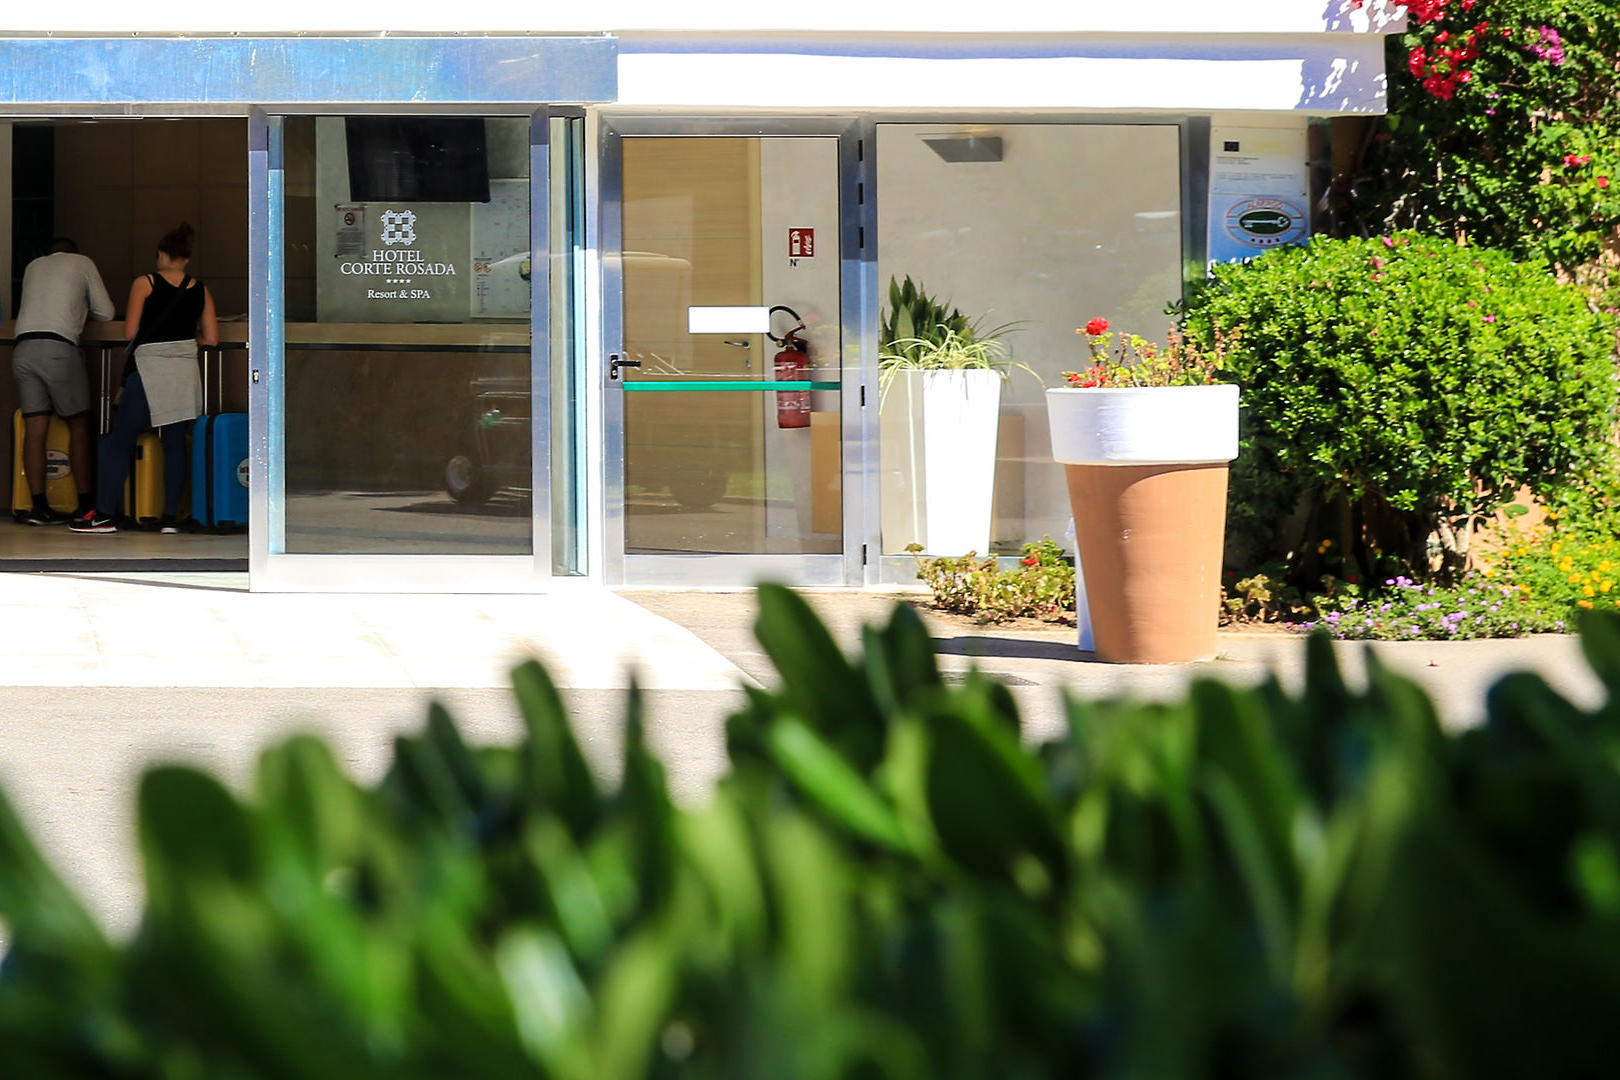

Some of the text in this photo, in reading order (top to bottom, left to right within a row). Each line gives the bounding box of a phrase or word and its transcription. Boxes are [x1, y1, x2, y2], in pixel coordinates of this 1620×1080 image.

[373, 250, 424, 262] HOTEL
[340, 262, 456, 275] CORTE ROSADA
[367, 289, 430, 299] Resort & SPA
